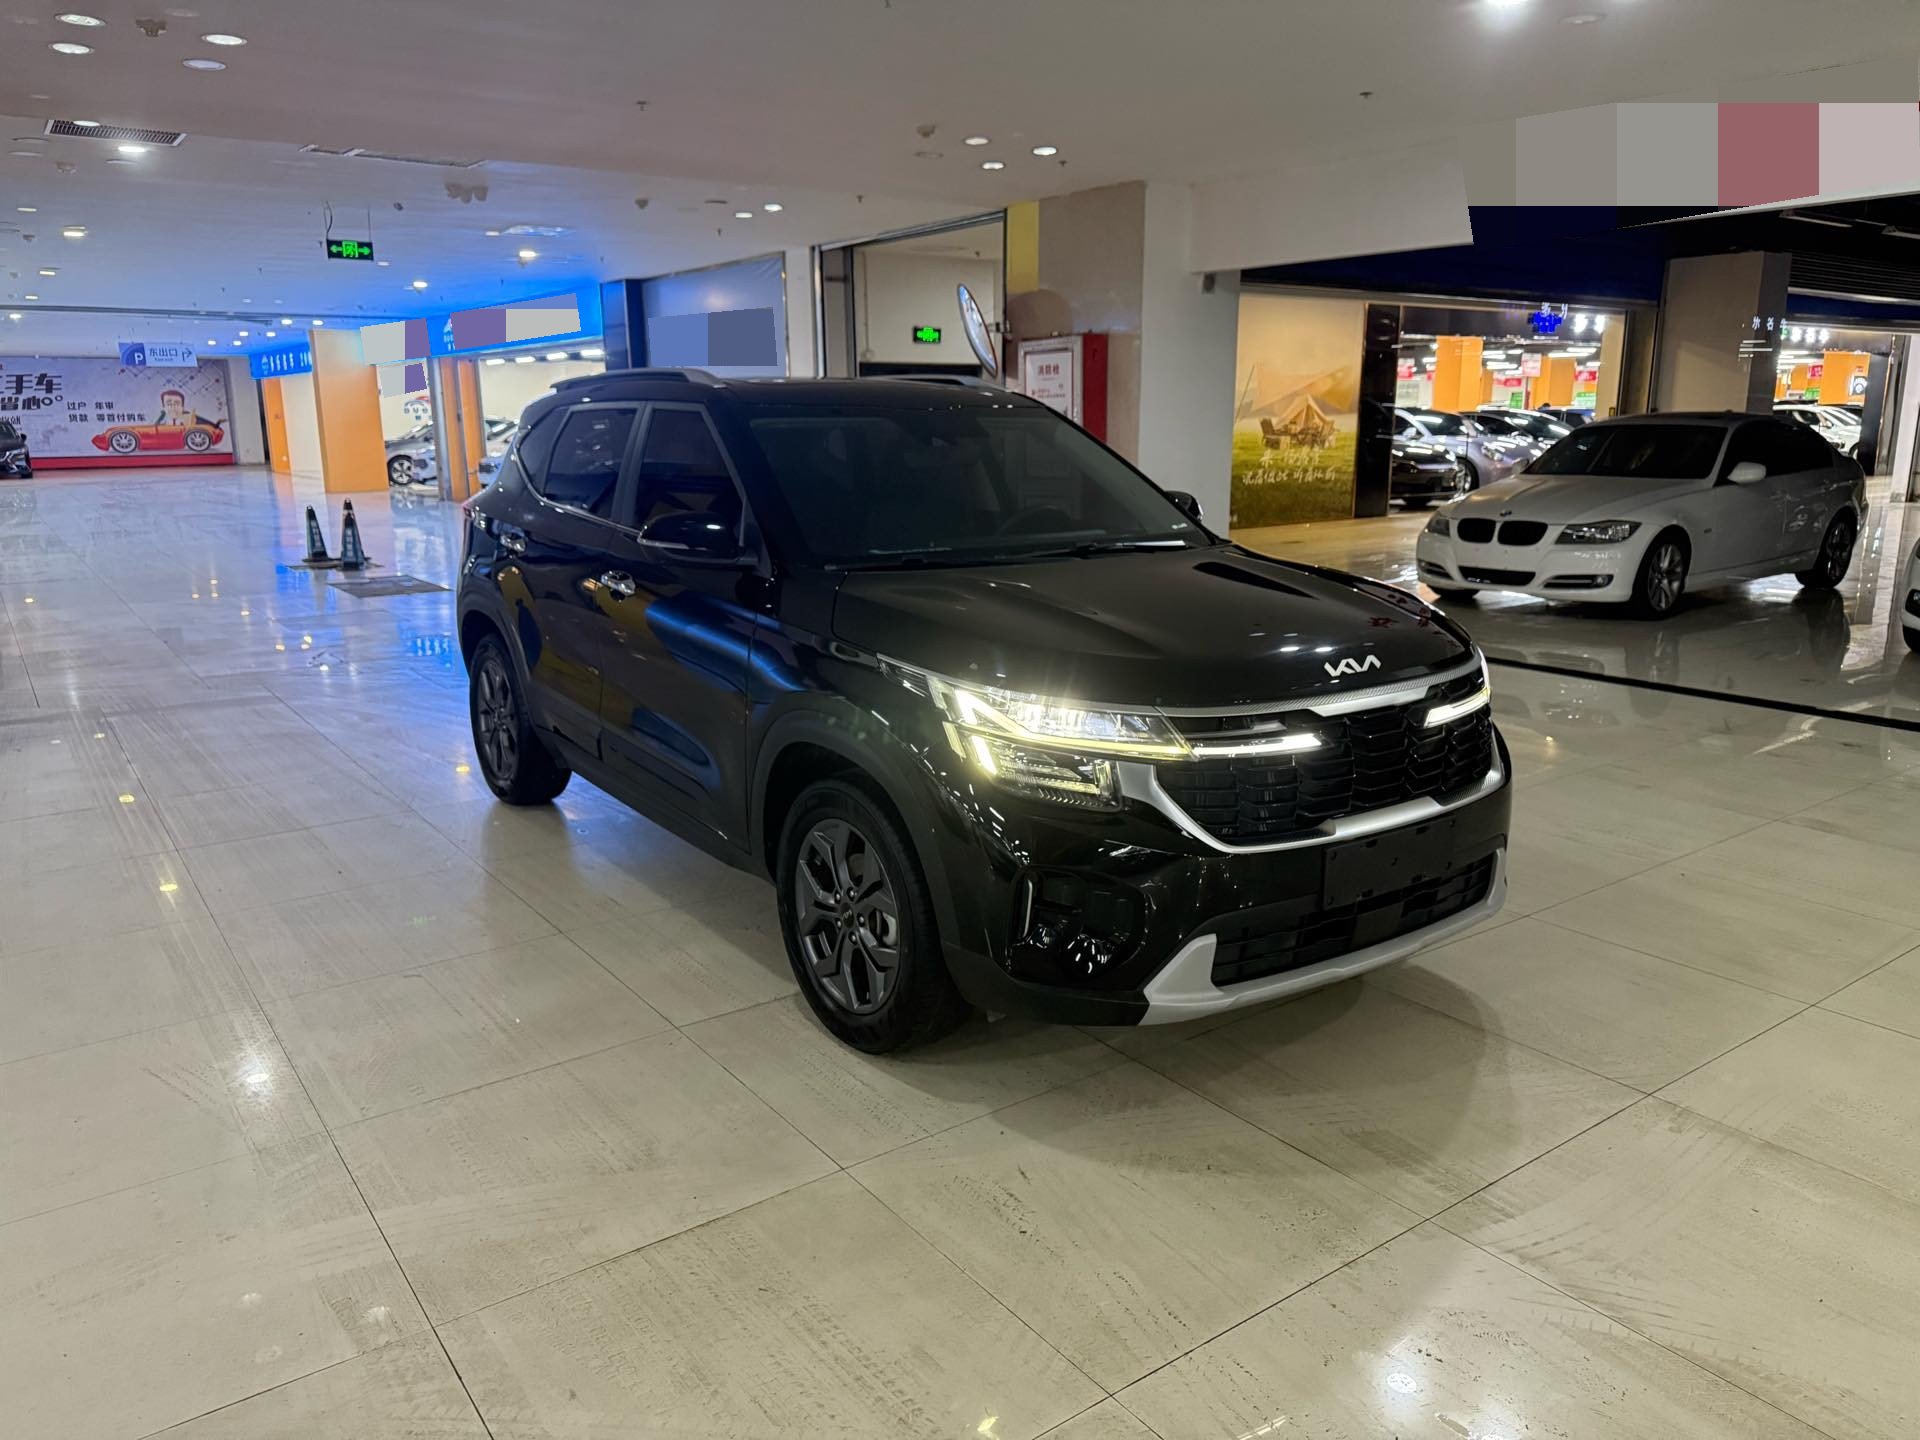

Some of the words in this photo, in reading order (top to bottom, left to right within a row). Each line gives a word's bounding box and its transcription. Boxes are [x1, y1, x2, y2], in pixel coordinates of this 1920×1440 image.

[149, 347, 178, 357] 东出口
[67, 401, 87, 410] 过户
[95, 401, 114, 410] 年审
[68, 413, 89, 422] 贷款
[96, 413, 146, 422] 零首付购车
